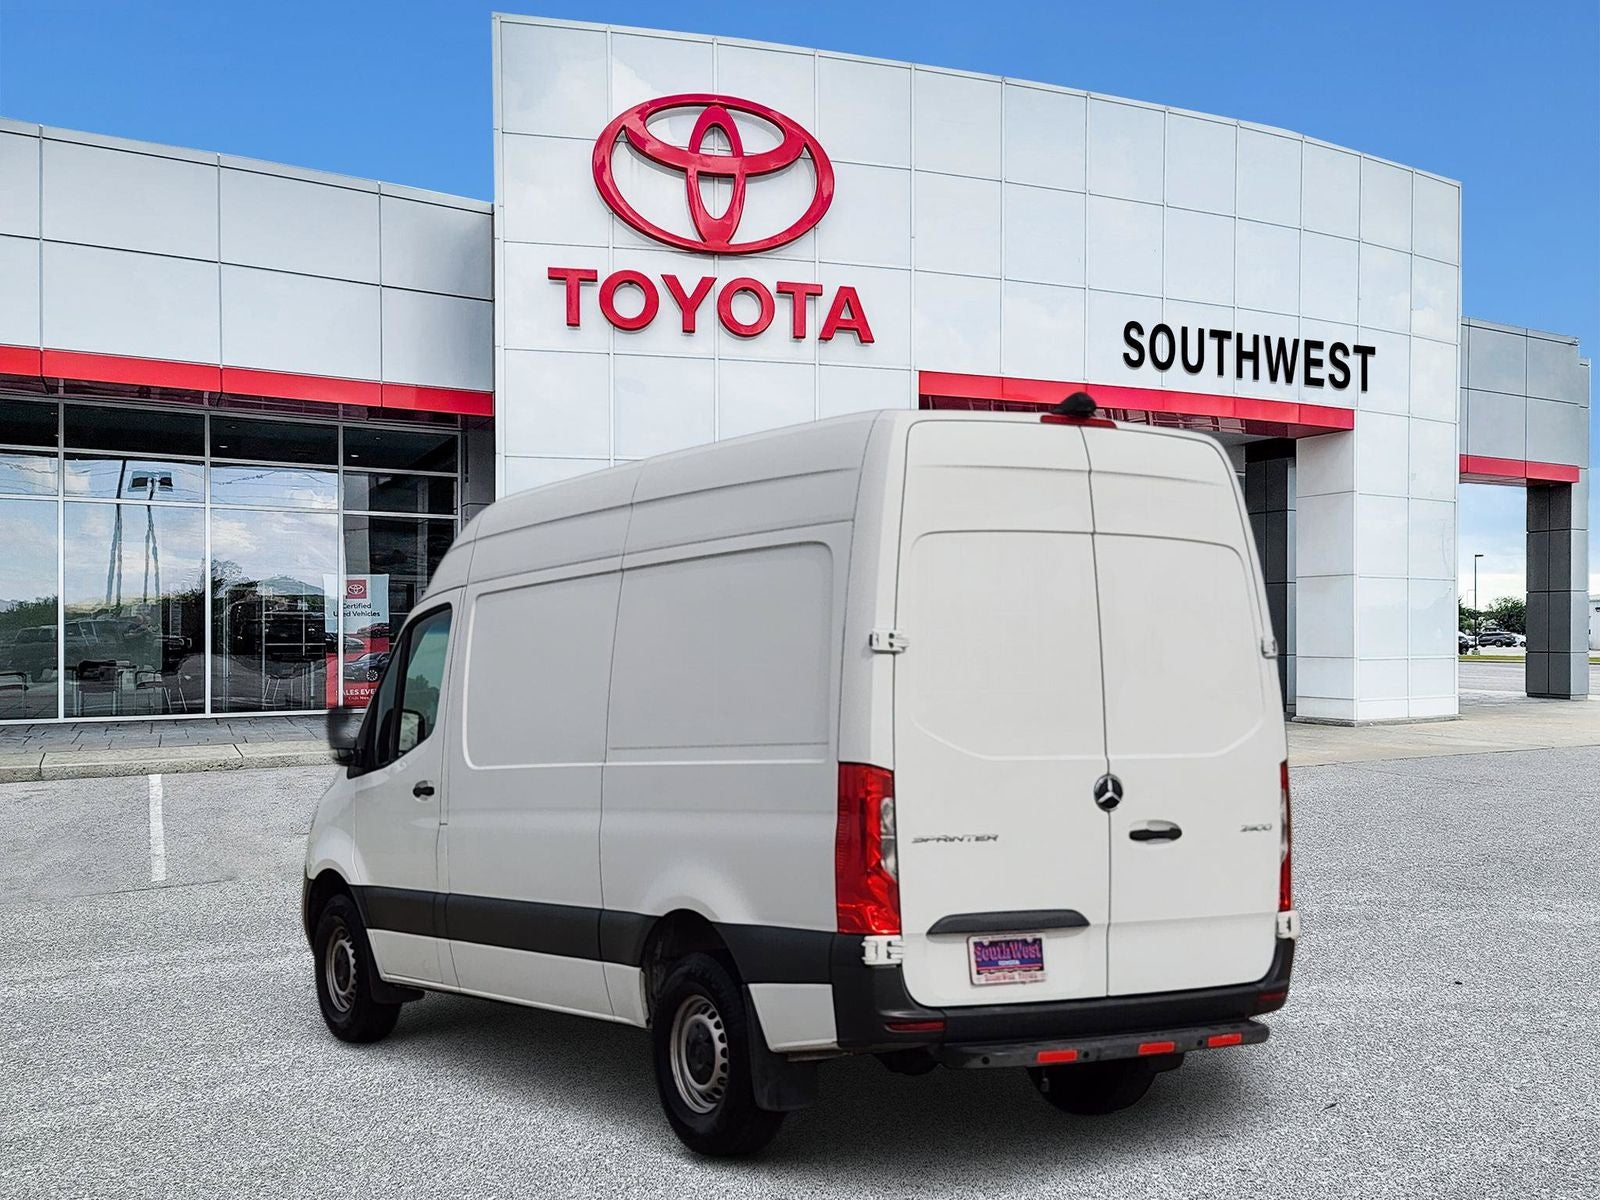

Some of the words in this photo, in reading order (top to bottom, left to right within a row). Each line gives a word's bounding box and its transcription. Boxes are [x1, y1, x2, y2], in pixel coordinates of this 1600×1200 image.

[547, 266, 875, 344] TOYOTA
[1123, 320, 1376, 393] SOUTHWEST
[342, 602, 372, 610] Certified
[911, 834, 999, 844] SPRINTER
